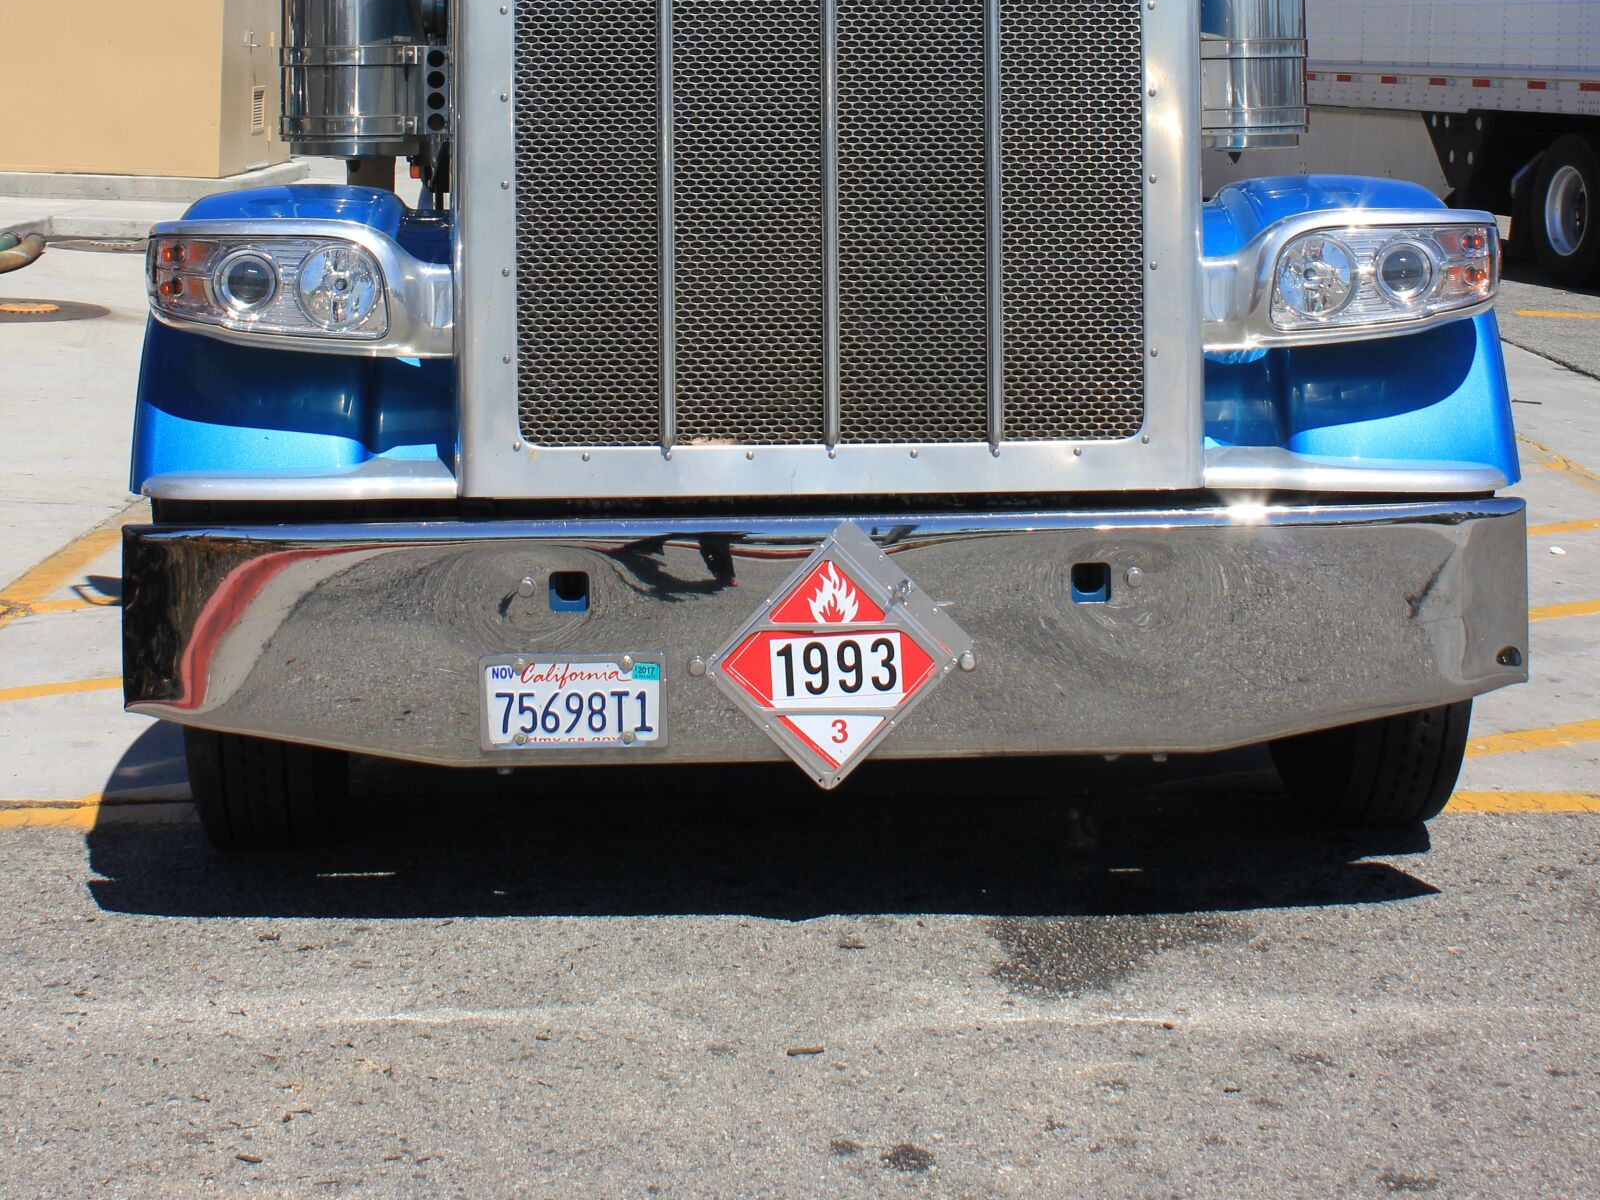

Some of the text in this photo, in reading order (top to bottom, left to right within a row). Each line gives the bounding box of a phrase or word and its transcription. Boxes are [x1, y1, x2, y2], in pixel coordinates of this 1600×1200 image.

[491, 662, 655, 689] NOV California 2017
[776, 637, 898, 697] 1993
[495, 690, 654, 734] 75698T1
[831, 719, 849, 744] 3
